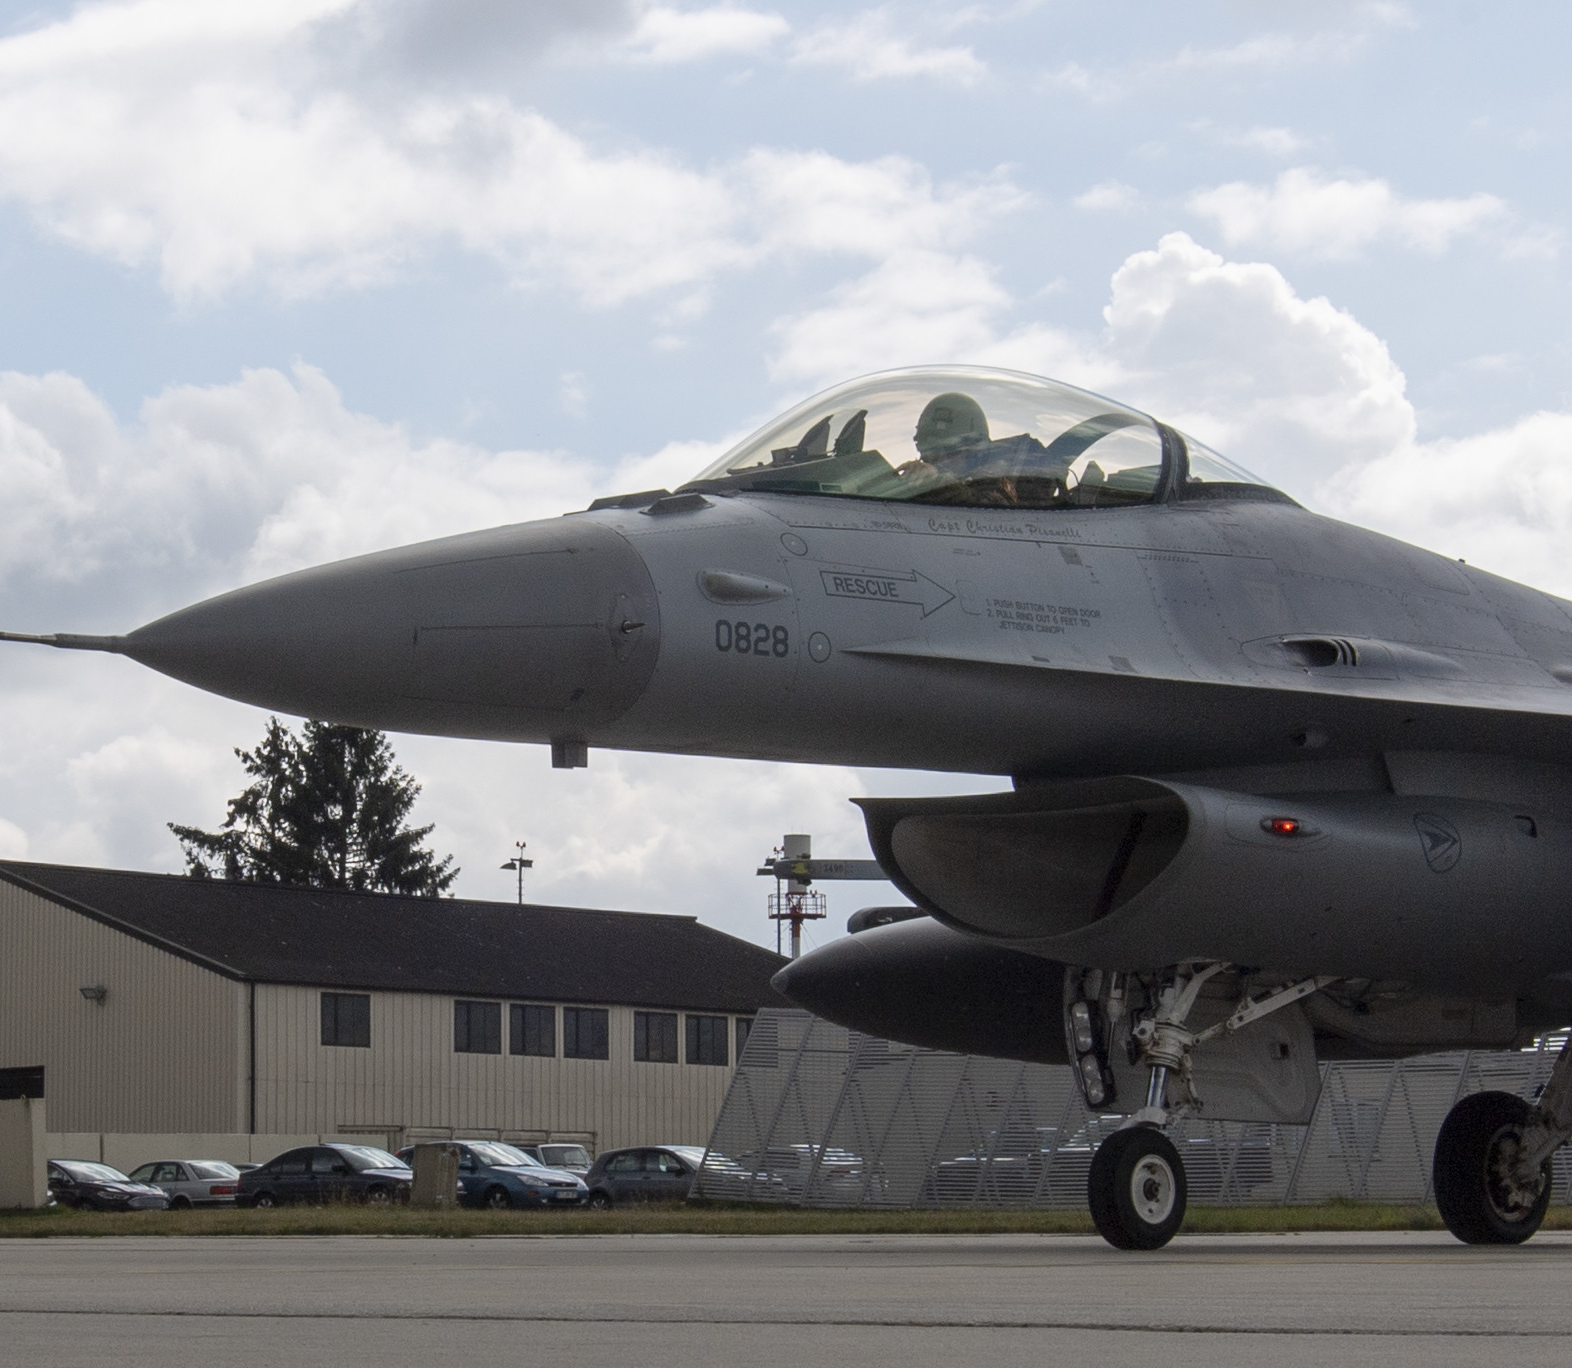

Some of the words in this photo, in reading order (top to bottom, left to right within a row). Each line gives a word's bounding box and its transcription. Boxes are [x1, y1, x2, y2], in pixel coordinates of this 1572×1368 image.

[928, 518, 960, 532] Capt
[966, 519, 1024, 534] Christian
[833, 576, 899, 598] RESCUE
[993, 599, 1014, 609] PUSH
[1015, 601, 1044, 611] BUTTON
[1047, 604, 1057, 614] TO
[1058, 606, 1078, 616] OPEN
[1079, 608, 1102, 618] DOOR
[995, 609, 1014, 619] PULL
[1036, 613, 1050, 623] OUT
[1052, 615, 1059, 624] 6
[1060, 616, 1078, 626] FEET
[1080, 618, 1090, 627] TO
[999, 620, 1034, 632] JETTISON
[1036, 624, 1065, 634] CANOPY
[715, 619, 789, 658] 0828
